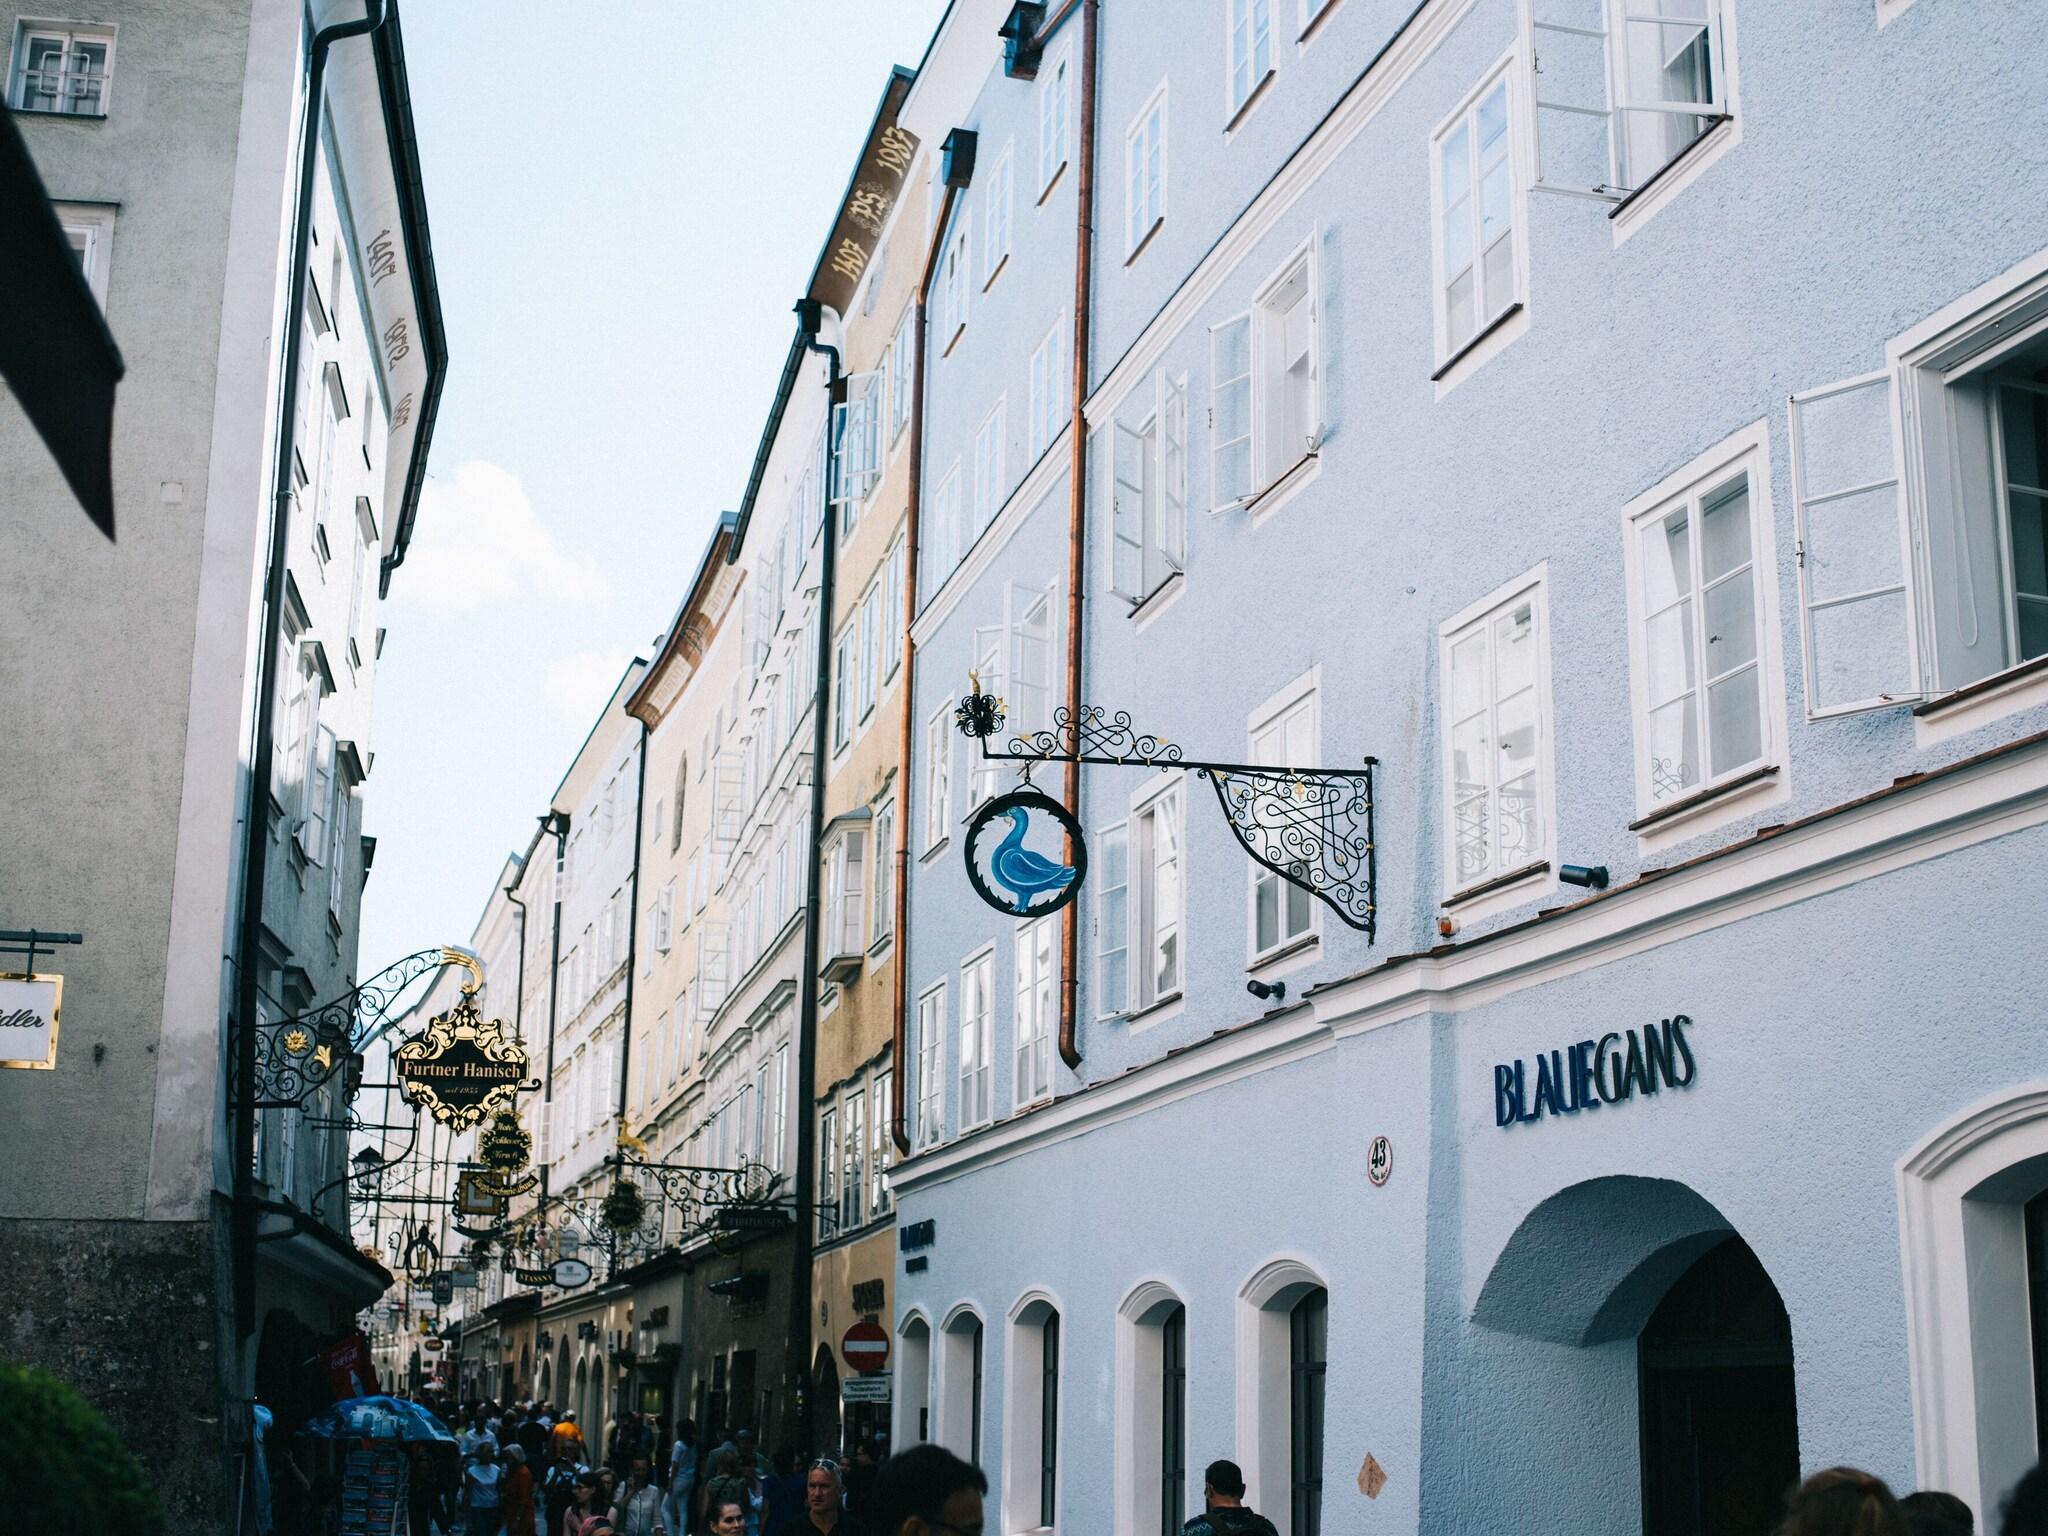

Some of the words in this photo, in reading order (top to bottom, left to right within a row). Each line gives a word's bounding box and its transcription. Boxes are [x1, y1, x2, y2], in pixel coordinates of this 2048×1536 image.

[875, 126, 914, 178] 1987
[404, 1061, 459, 1077] Furtner
[464, 1062, 520, 1078] Hanisch
[1494, 1014, 1694, 1126] BLAUEGANS
[1372, 1139, 1386, 1168] 43
